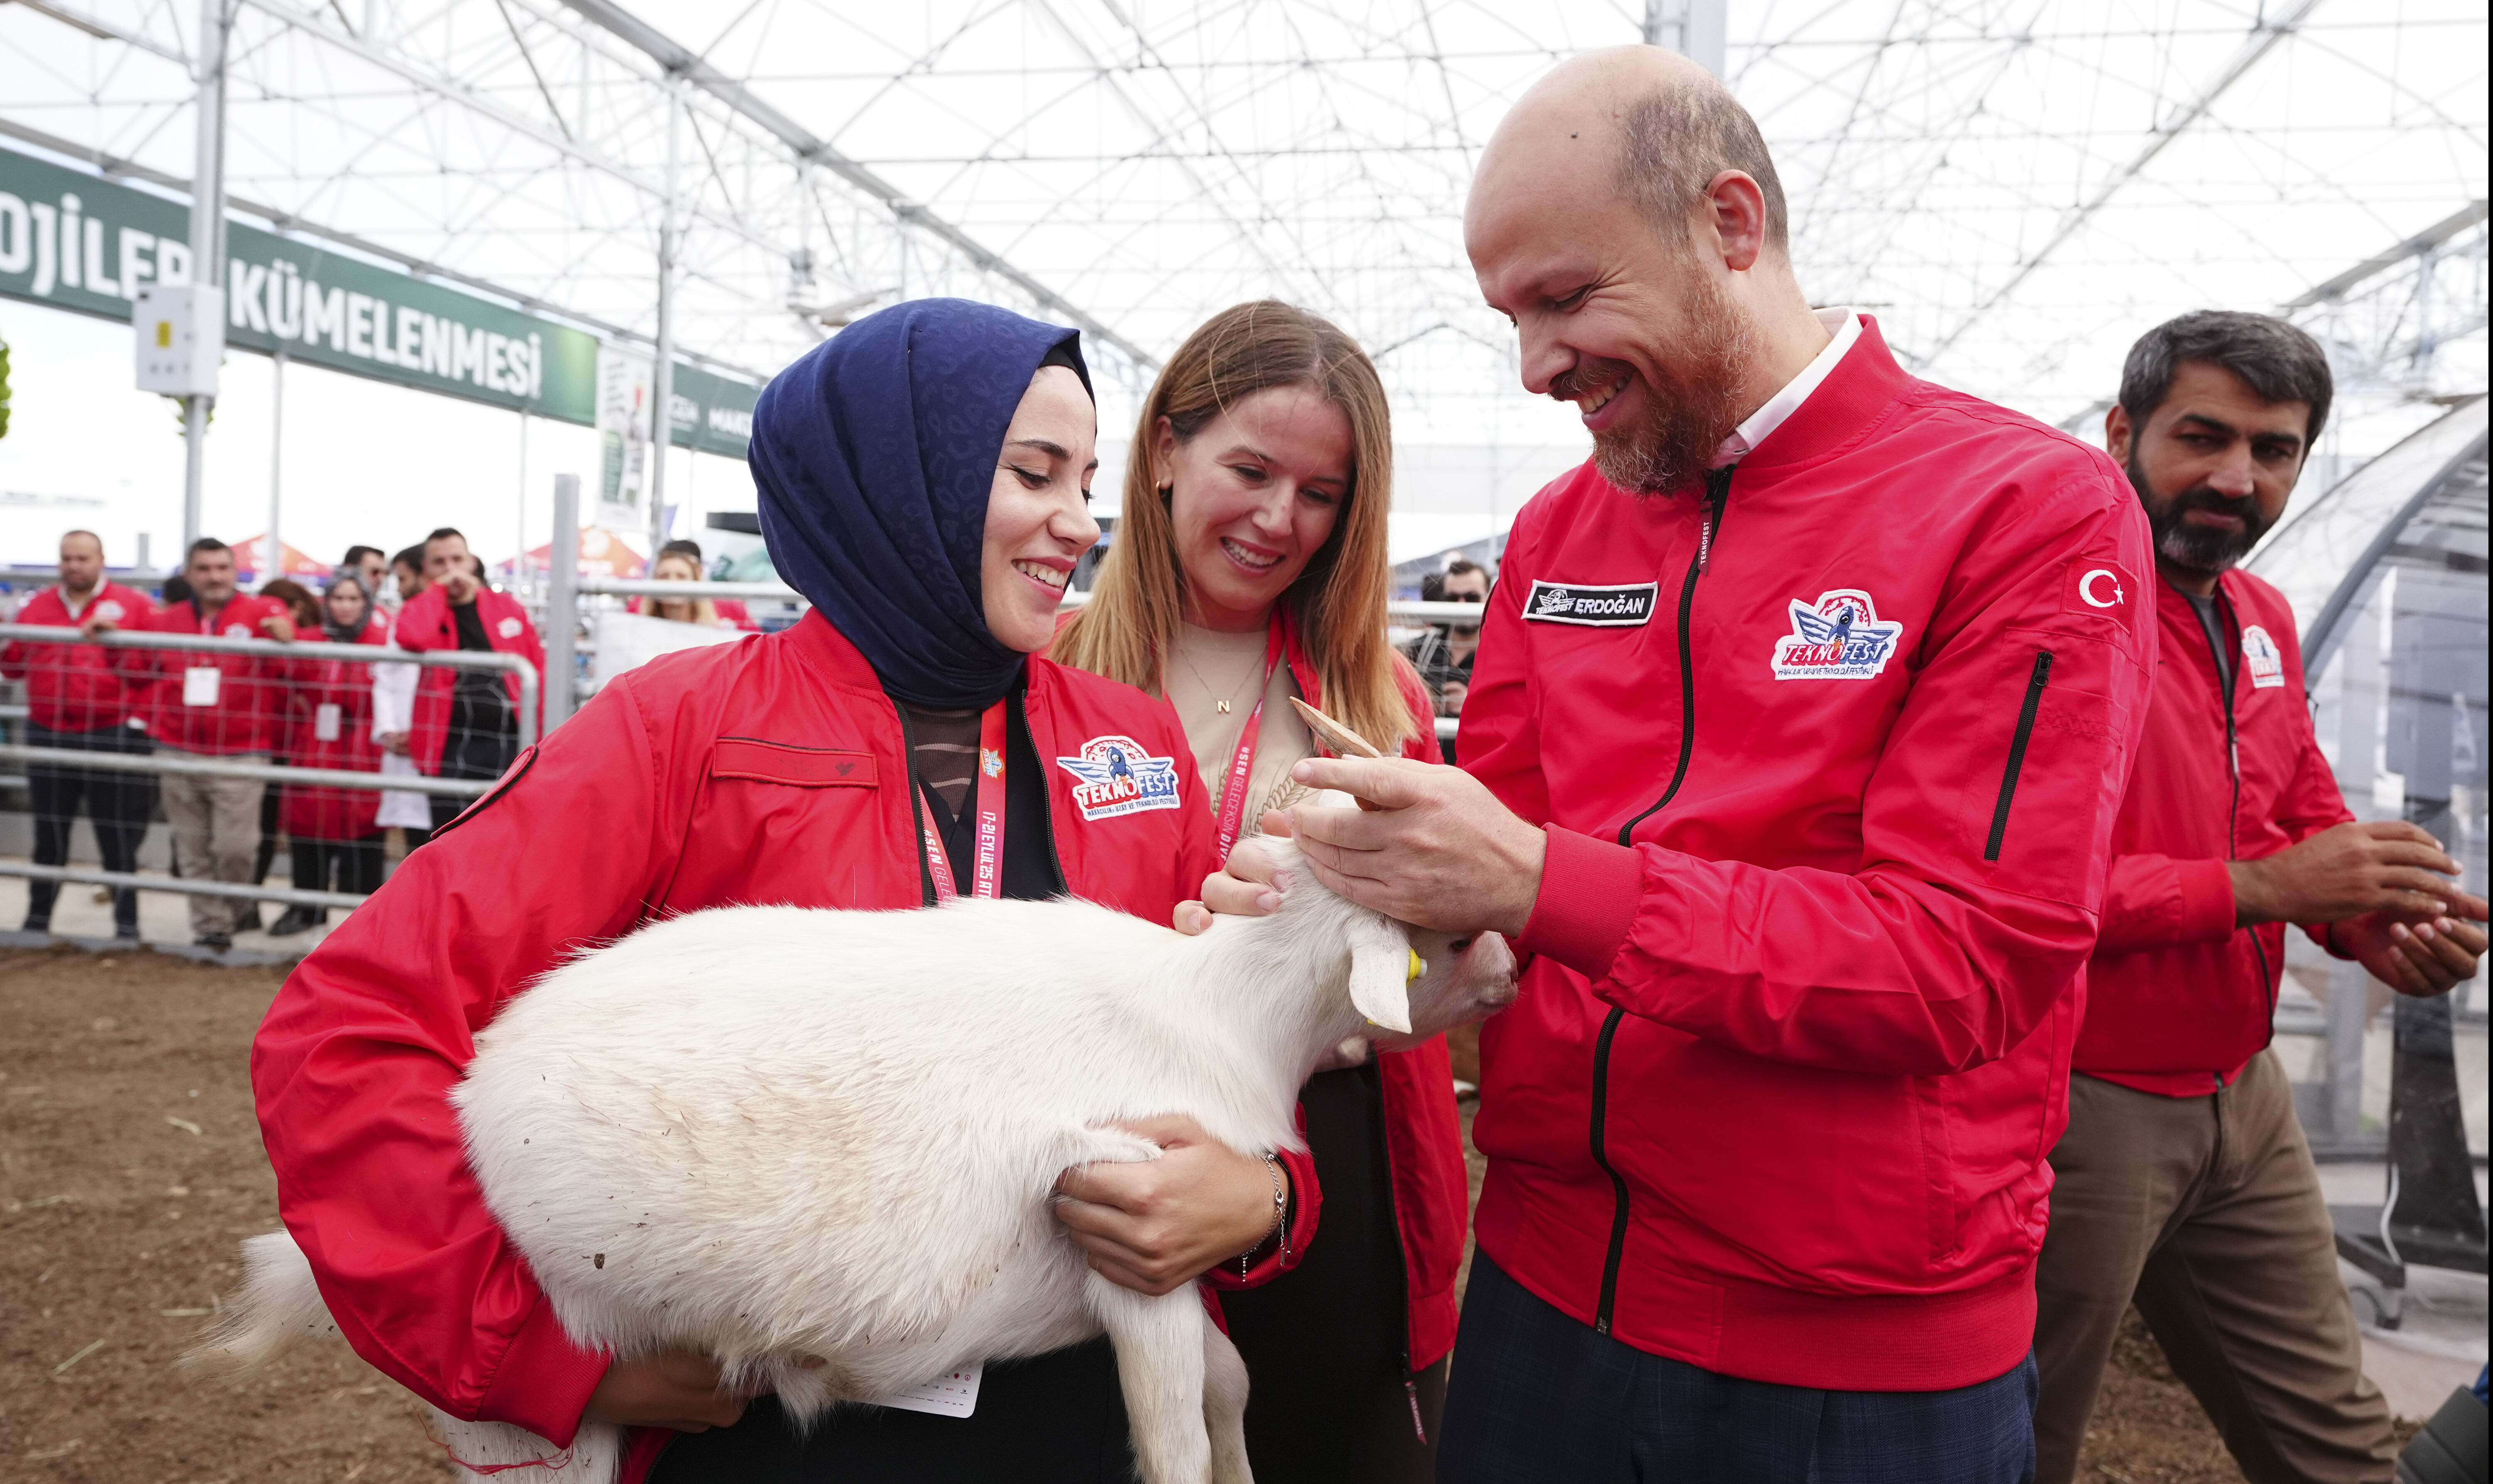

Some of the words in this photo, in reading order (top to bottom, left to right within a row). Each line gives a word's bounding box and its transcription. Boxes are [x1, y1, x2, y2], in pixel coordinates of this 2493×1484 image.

[229, 258, 542, 400] KÜMELENMESİ
[1700, 522, 1709, 565] TEKNOFEST
[1536, 602, 1574, 614] TEKNOFEST
[1574, 594, 1645, 614] ERDOĞAN
[1782, 642, 1888, 665] TEKNOFEST
[1217, 700, 1230, 713] N
[1235, 747, 1250, 776] #SEN
[1077, 772, 1175, 809] TEKNOFEST
[923, 830, 943, 865] #SEN
